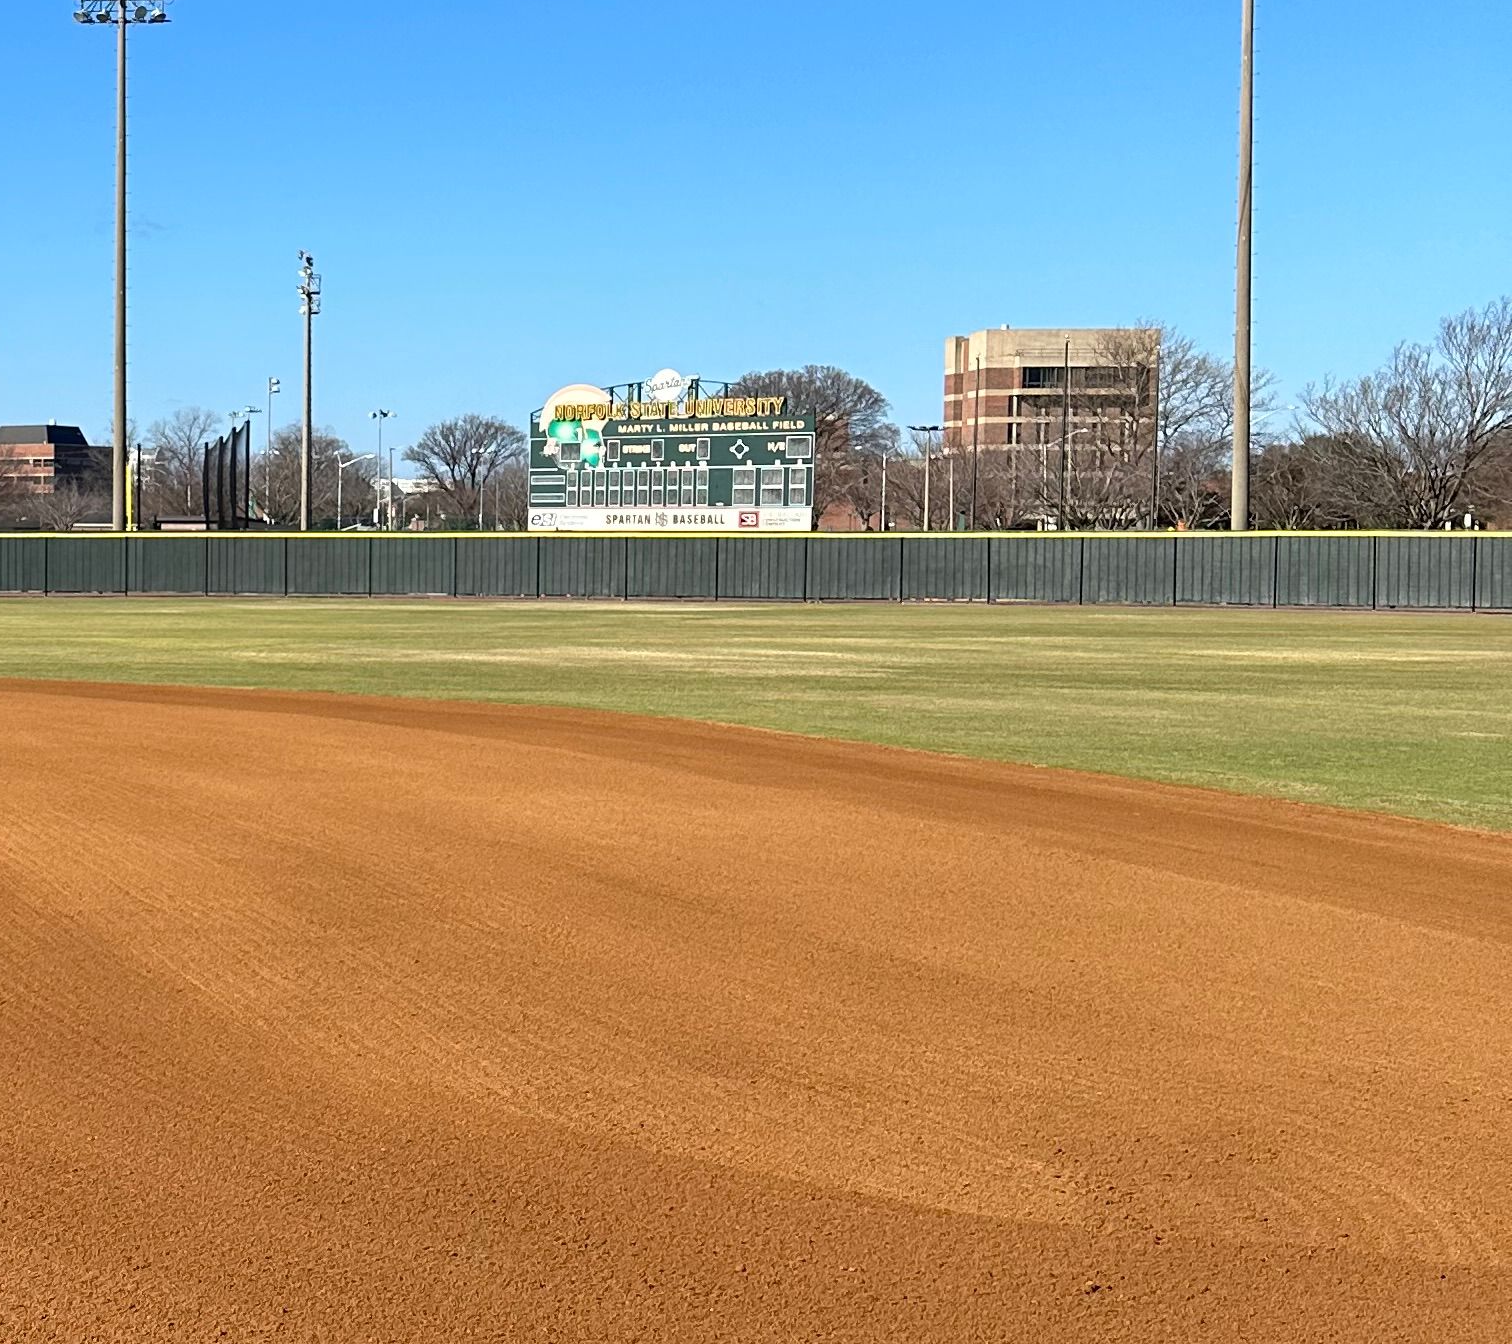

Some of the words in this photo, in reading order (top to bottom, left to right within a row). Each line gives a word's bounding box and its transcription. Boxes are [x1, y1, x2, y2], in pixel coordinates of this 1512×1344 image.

[554, 403, 626, 422] NORFOLK
[630, 402, 677, 418] STATE
[686, 397, 784, 416] UNIVERSITY
[618, 424, 653, 433] MARTY
[656, 424, 666, 433] L.
[670, 423, 708, 432] MILLER
[712, 422, 769, 431] BASEBALL
[773, 420, 805, 430] FIELD
[606, 514, 650, 524] SPARTAN
[673, 514, 725, 524] BASEBALL
